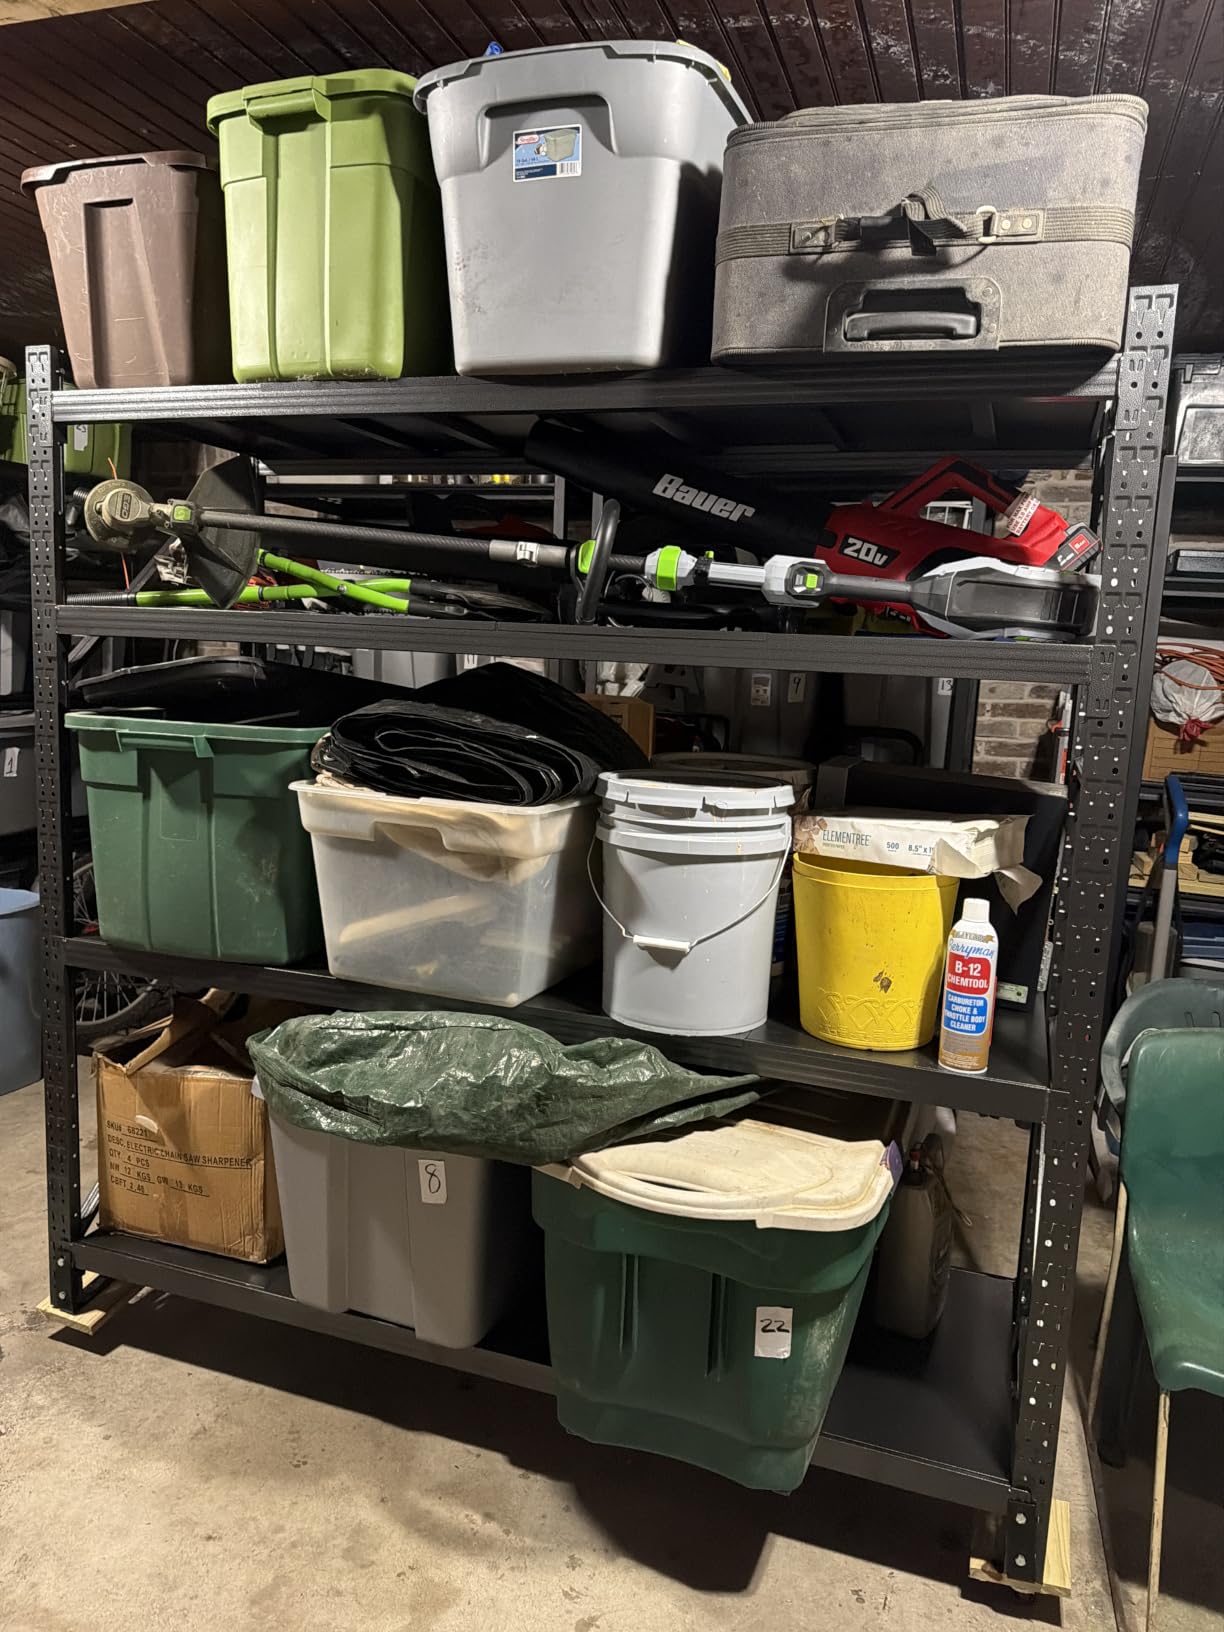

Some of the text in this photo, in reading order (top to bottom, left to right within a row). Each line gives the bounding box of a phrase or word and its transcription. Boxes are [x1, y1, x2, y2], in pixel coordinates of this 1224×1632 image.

[652, 473, 756, 522] Bauer
[121, 493, 131, 518] EGO
[1016, 510, 1033, 534] BATTERY
[941, 679, 954, 691] 13
[5, 757, 13, 774] 1
[822, 829, 870, 848] ELEMENTREE
[886, 841, 900, 850] 500
[955, 960, 981, 976] B-12
[947, 973, 989, 988] CHEMTOOL
[948, 993, 984, 1006] CARBURETOR
[951, 1003, 978, 1015] CHOKE &
[950, 1020, 976, 1032] CLEANER
[970, 1015, 986, 1023] BODY
[135, 1157, 150, 1168] PCS
[202, 1155, 252, 1167] SHARPENER
[136, 1170, 151, 1182] KGS
[188, 1183, 203, 1194] KGS
[424, 1163, 441, 1194] 8
[759, 1318, 791, 1334] 22
